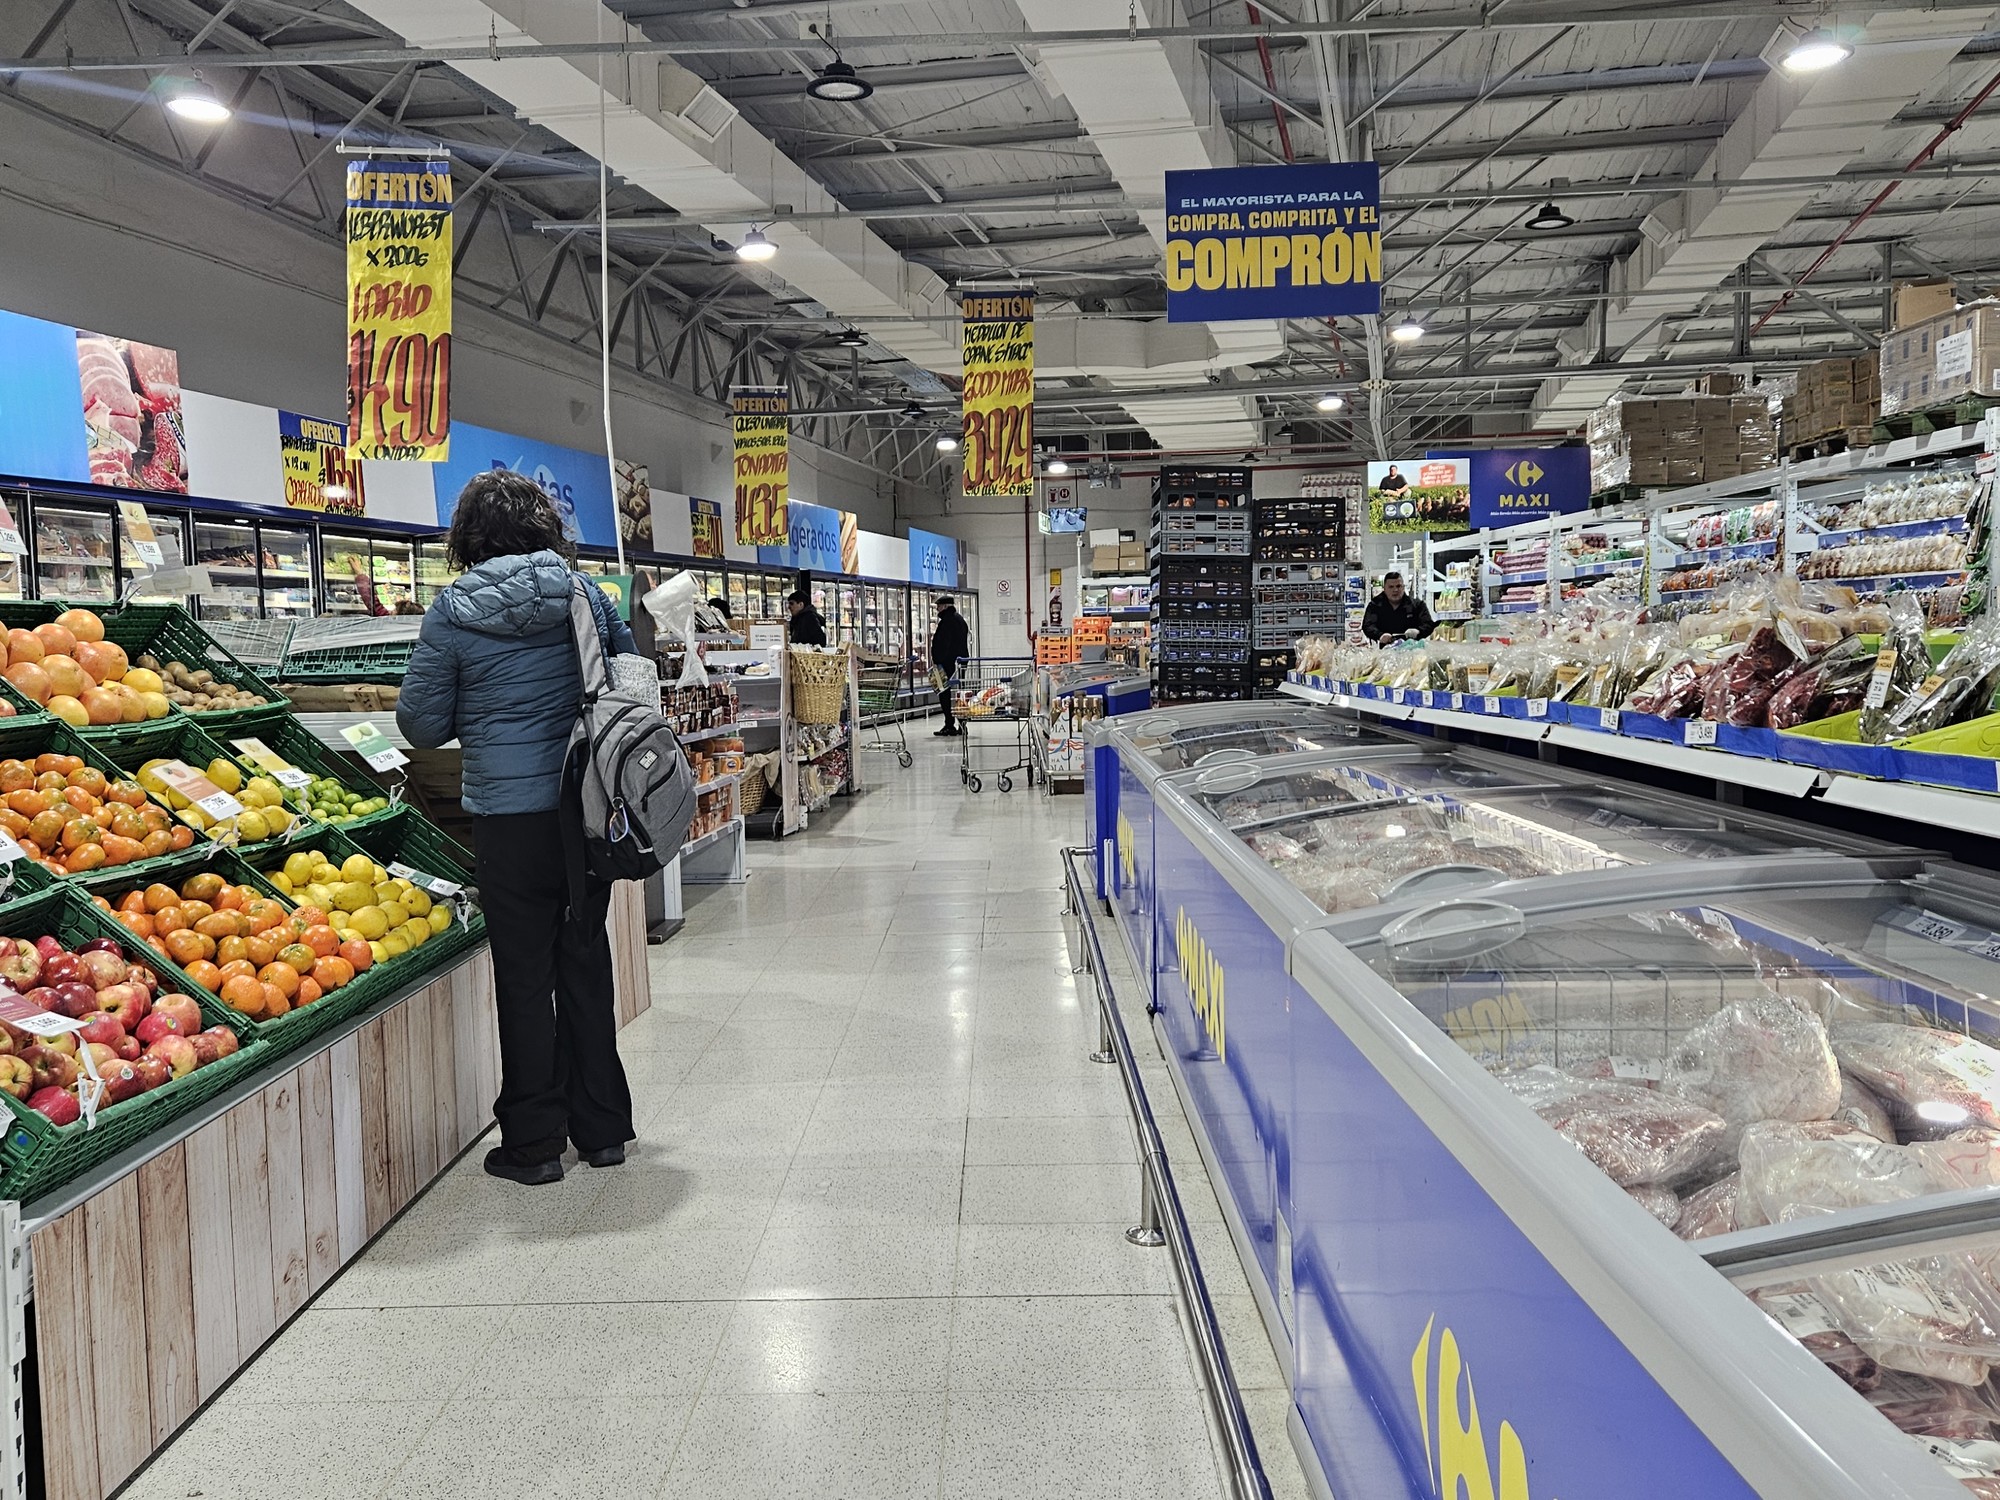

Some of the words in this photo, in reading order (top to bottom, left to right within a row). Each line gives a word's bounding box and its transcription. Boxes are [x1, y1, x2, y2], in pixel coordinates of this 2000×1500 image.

[1181, 198, 1200, 208] EL
[1202, 194, 1294, 207] MAYORISTA
[1297, 191, 1338, 203] PARA
[1343, 190, 1364, 201] LA
[1167, 212, 1245, 233] COMPRA,
[1248, 208, 1338, 229] COMPRITA
[1345, 206, 1356, 224] Y
[1359, 205, 1379, 224] EL
[1166, 226, 1382, 292] COMPRÓN
[1499, 493, 1550, 508] MAXI
[1920, 922, 1954, 939] 9.350
